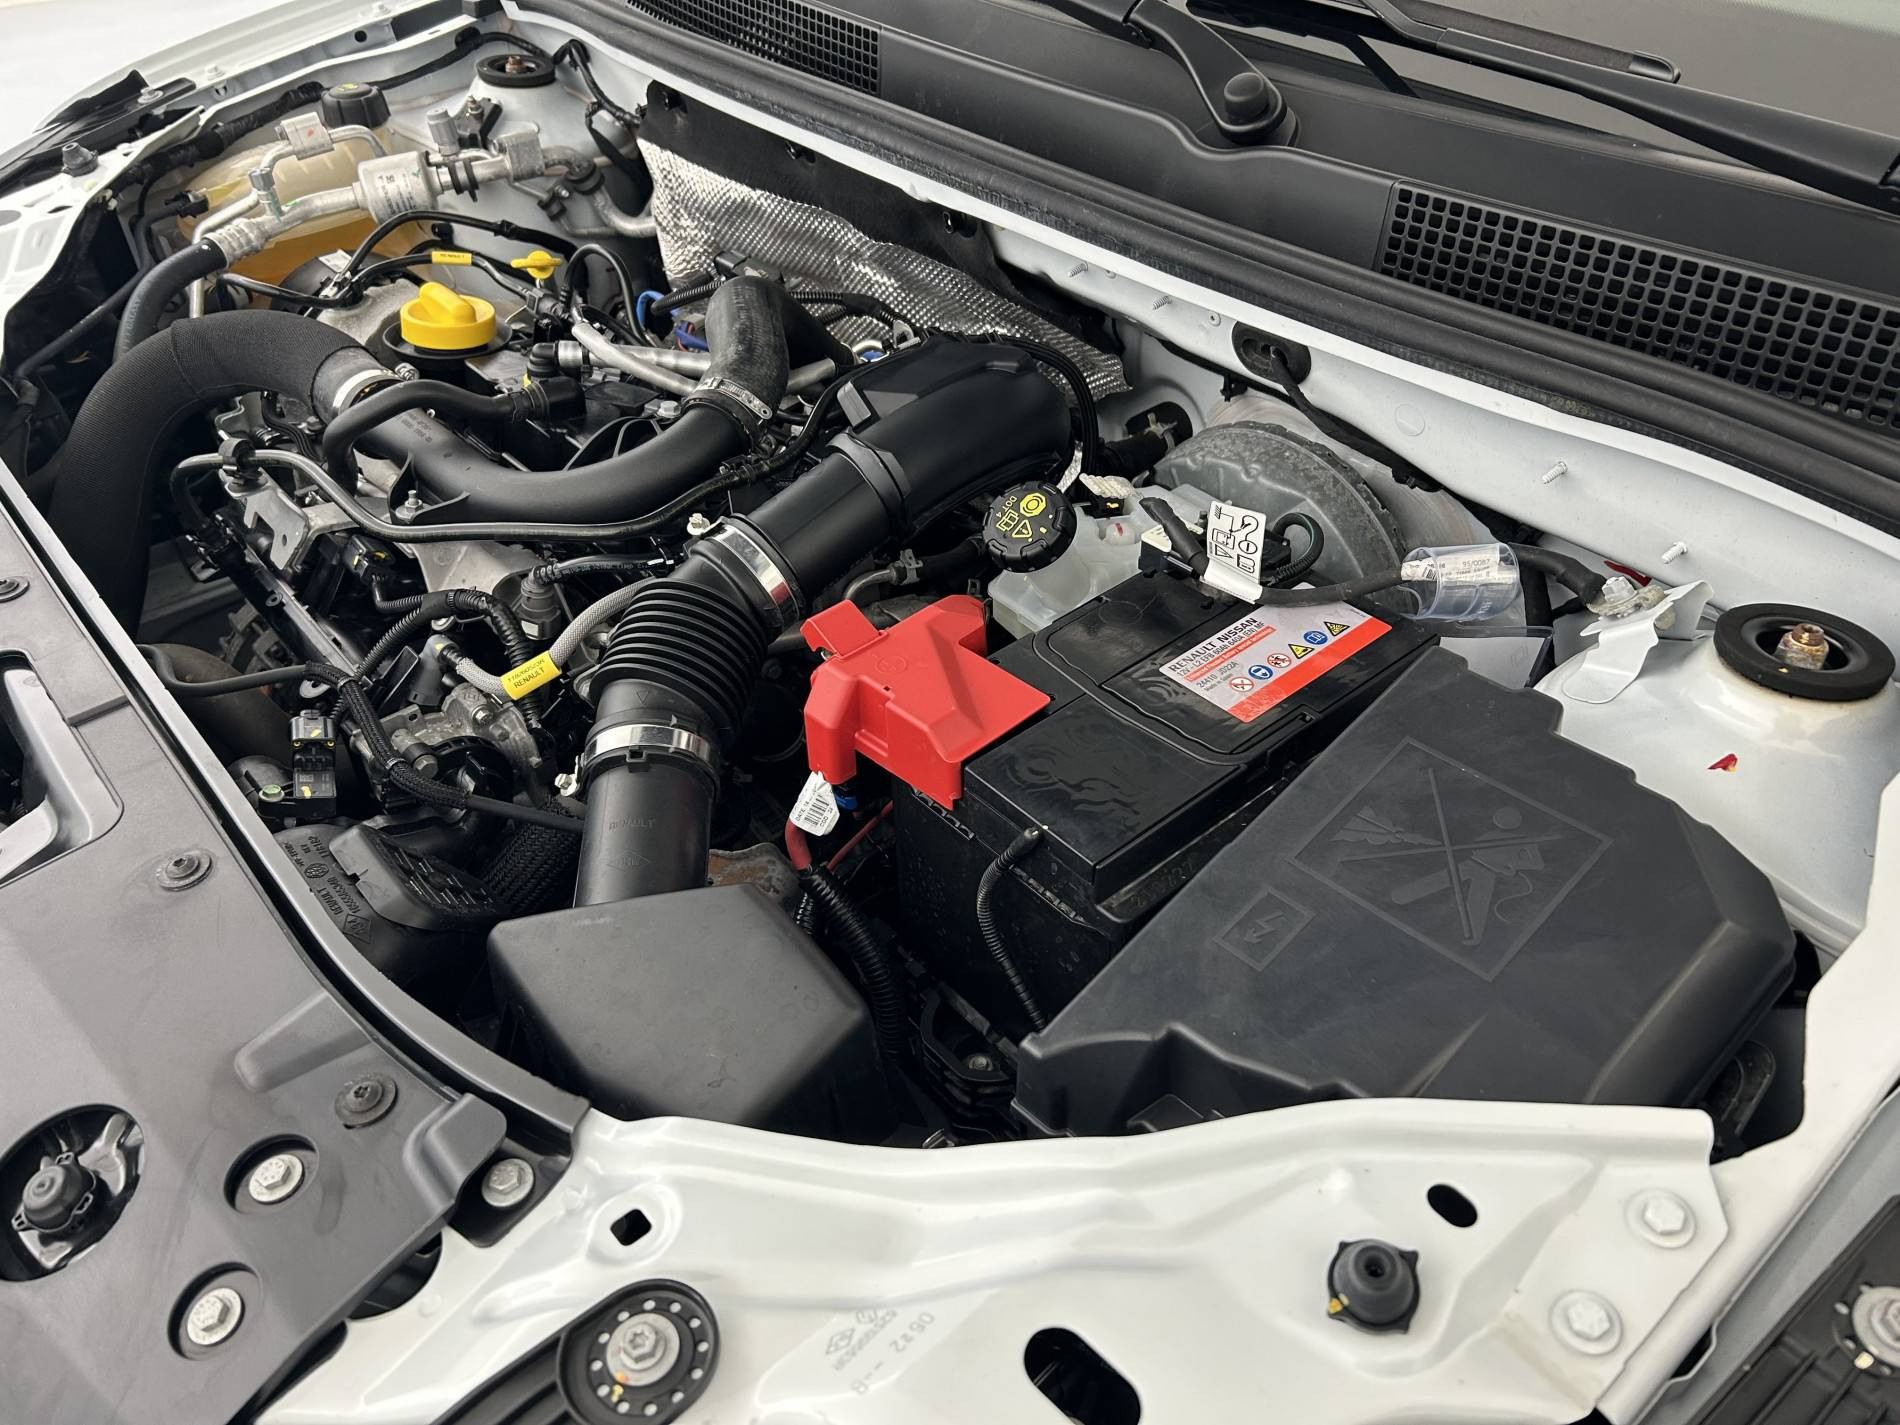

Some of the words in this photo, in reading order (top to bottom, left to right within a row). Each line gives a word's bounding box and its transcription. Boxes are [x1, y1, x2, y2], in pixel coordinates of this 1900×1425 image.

[1002, 495, 1018, 512] DOT
[1168, 641, 1217, 672] RENAULT
[1216, 617, 1258, 642] NISSAN
[513, 667, 546, 688] RENAULT
